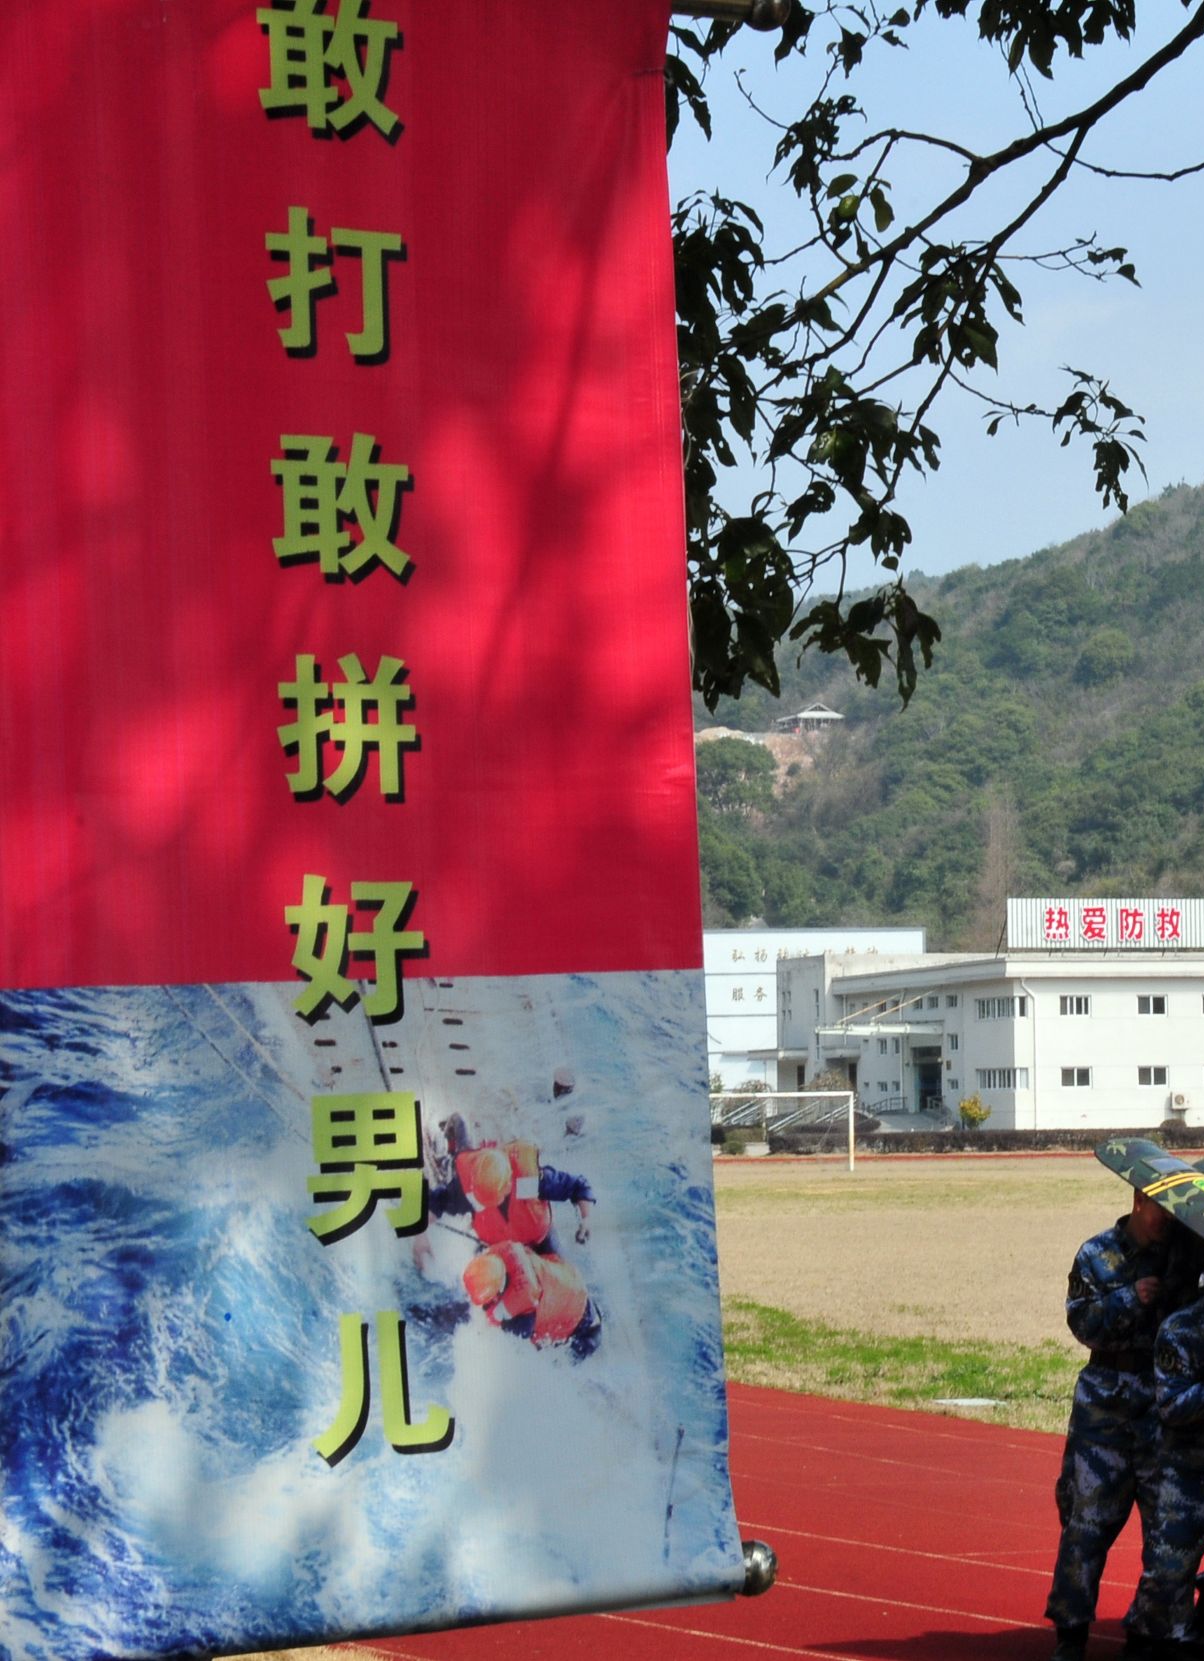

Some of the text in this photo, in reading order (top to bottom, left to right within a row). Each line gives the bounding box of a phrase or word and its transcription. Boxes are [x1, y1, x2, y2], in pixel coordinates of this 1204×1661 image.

[256, 0, 454, 1467] 敢打敢拼好男儿
[1044, 906, 1182, 940] 热爱防救
